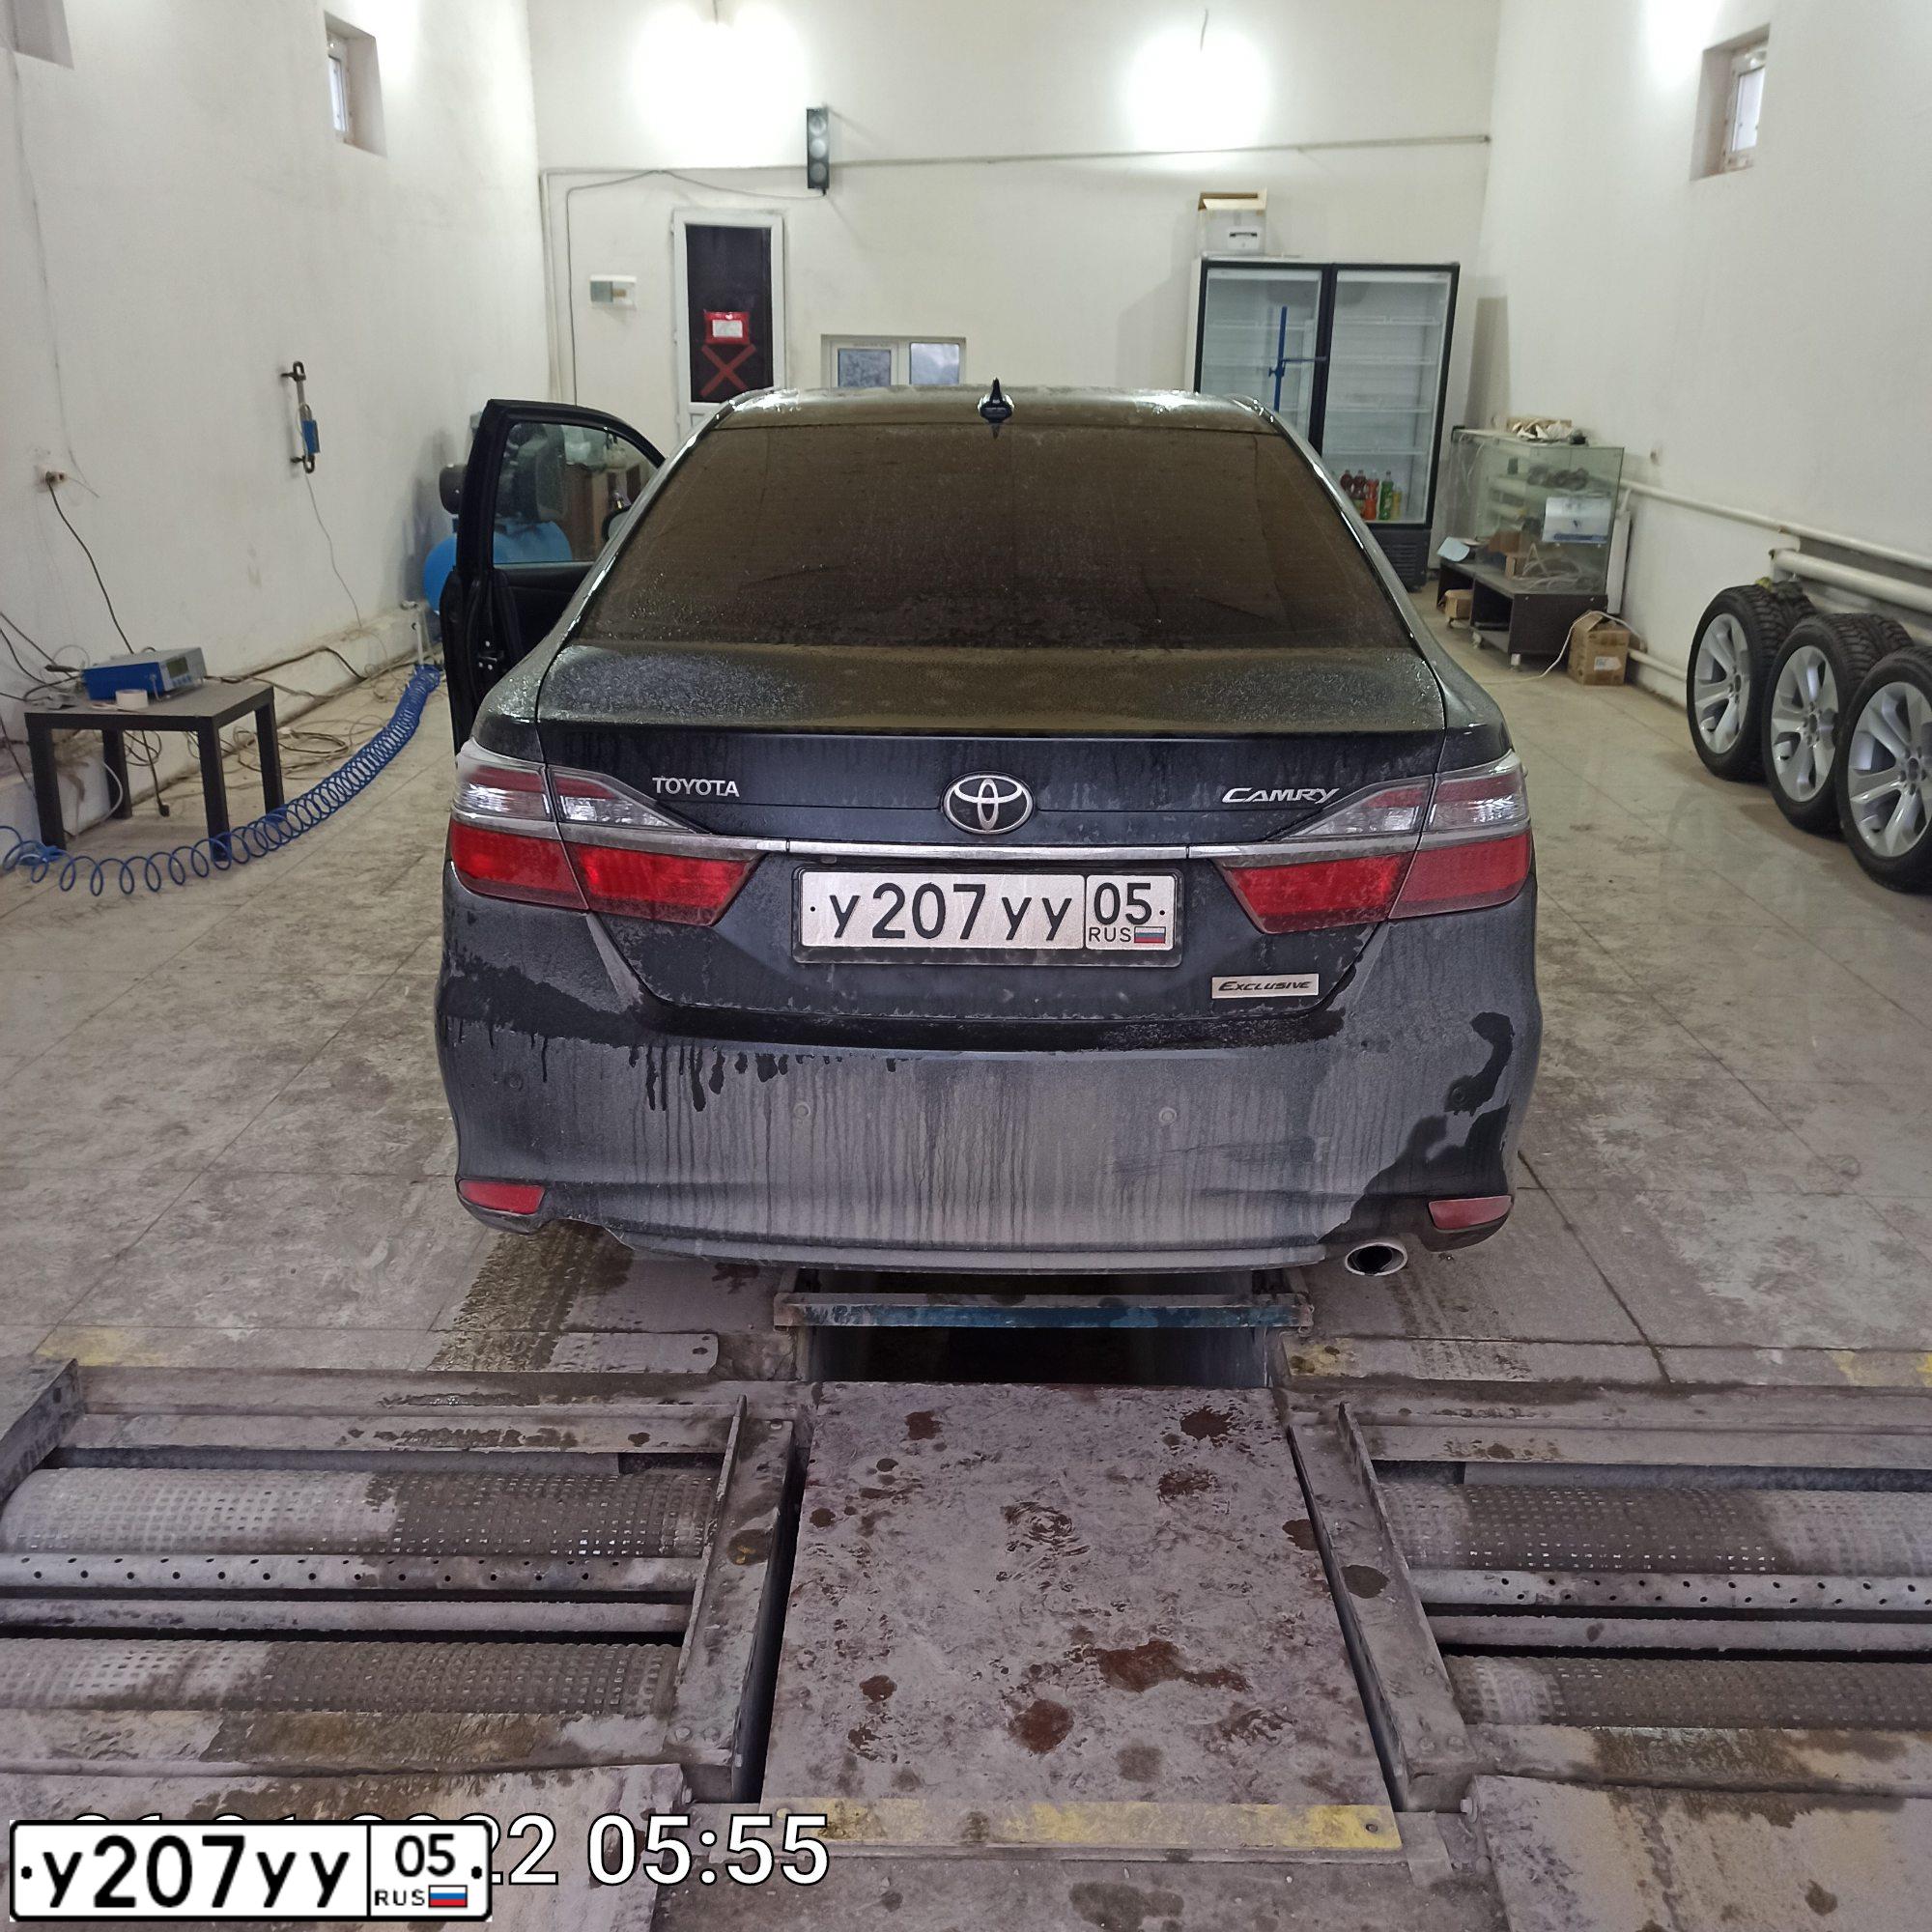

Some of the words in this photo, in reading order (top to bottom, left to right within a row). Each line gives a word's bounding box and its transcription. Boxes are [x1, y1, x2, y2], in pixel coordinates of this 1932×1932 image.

[652, 777, 740, 797] TOYOTA
[1222, 787, 1341, 805] CAMRY
[1093, 882, 1152, 925] 05
[1089, 926, 1132, 943] RUS
[1218, 980, 1313, 992] EXCLUSIVE
